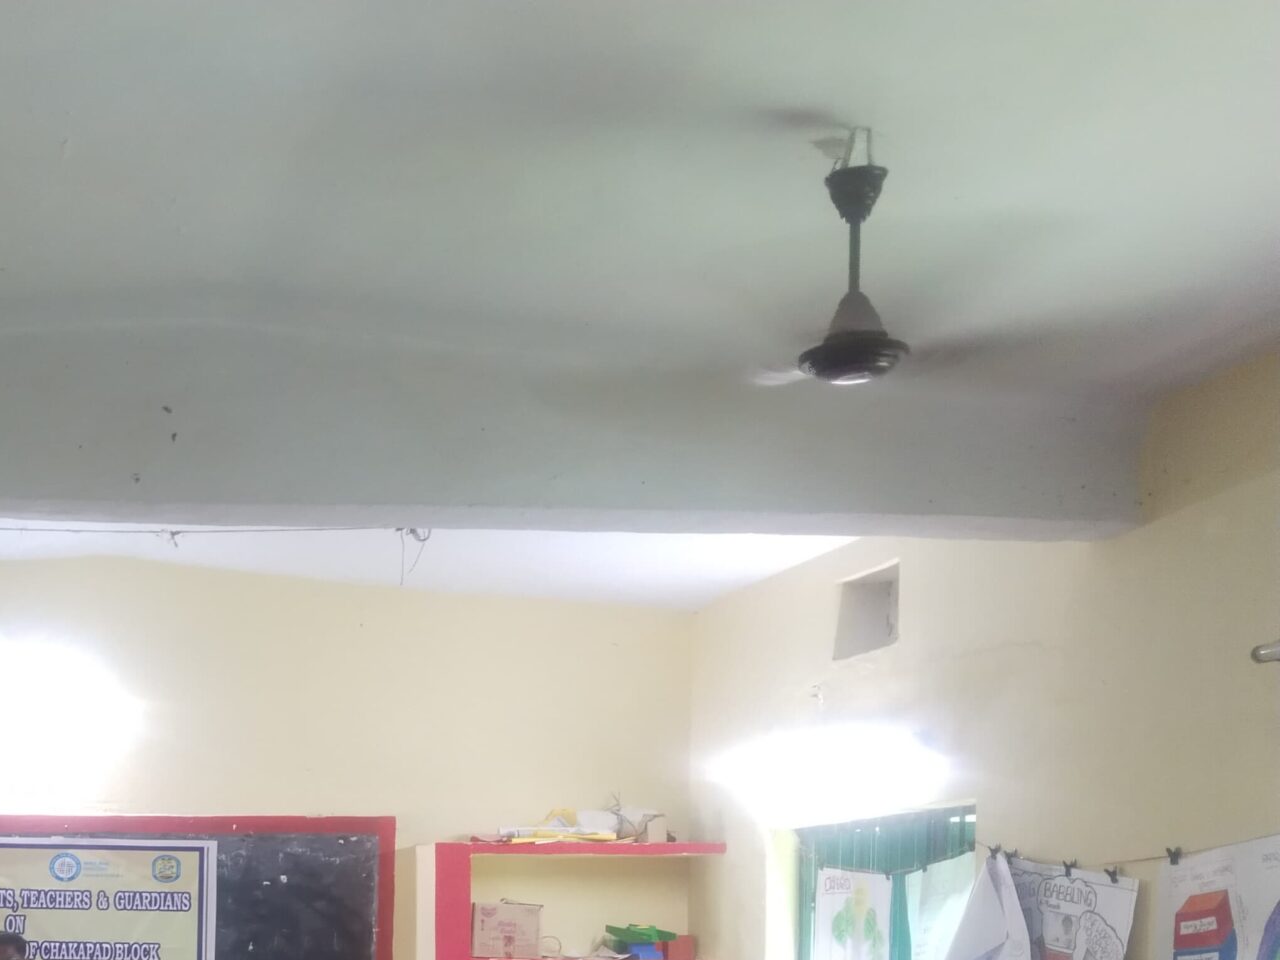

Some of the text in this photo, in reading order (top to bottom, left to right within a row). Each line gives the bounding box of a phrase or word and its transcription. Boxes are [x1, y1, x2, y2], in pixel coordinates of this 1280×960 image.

[21, 889, 91, 909] TEACHERS
[97, 890, 110, 910] &
[115, 891, 191, 911] GUARDIANS
[1043, 881, 1093, 908] BABBLING
[5, 914, 26, 934] ON
[41, 942, 113, 960] CHAKAPAD
